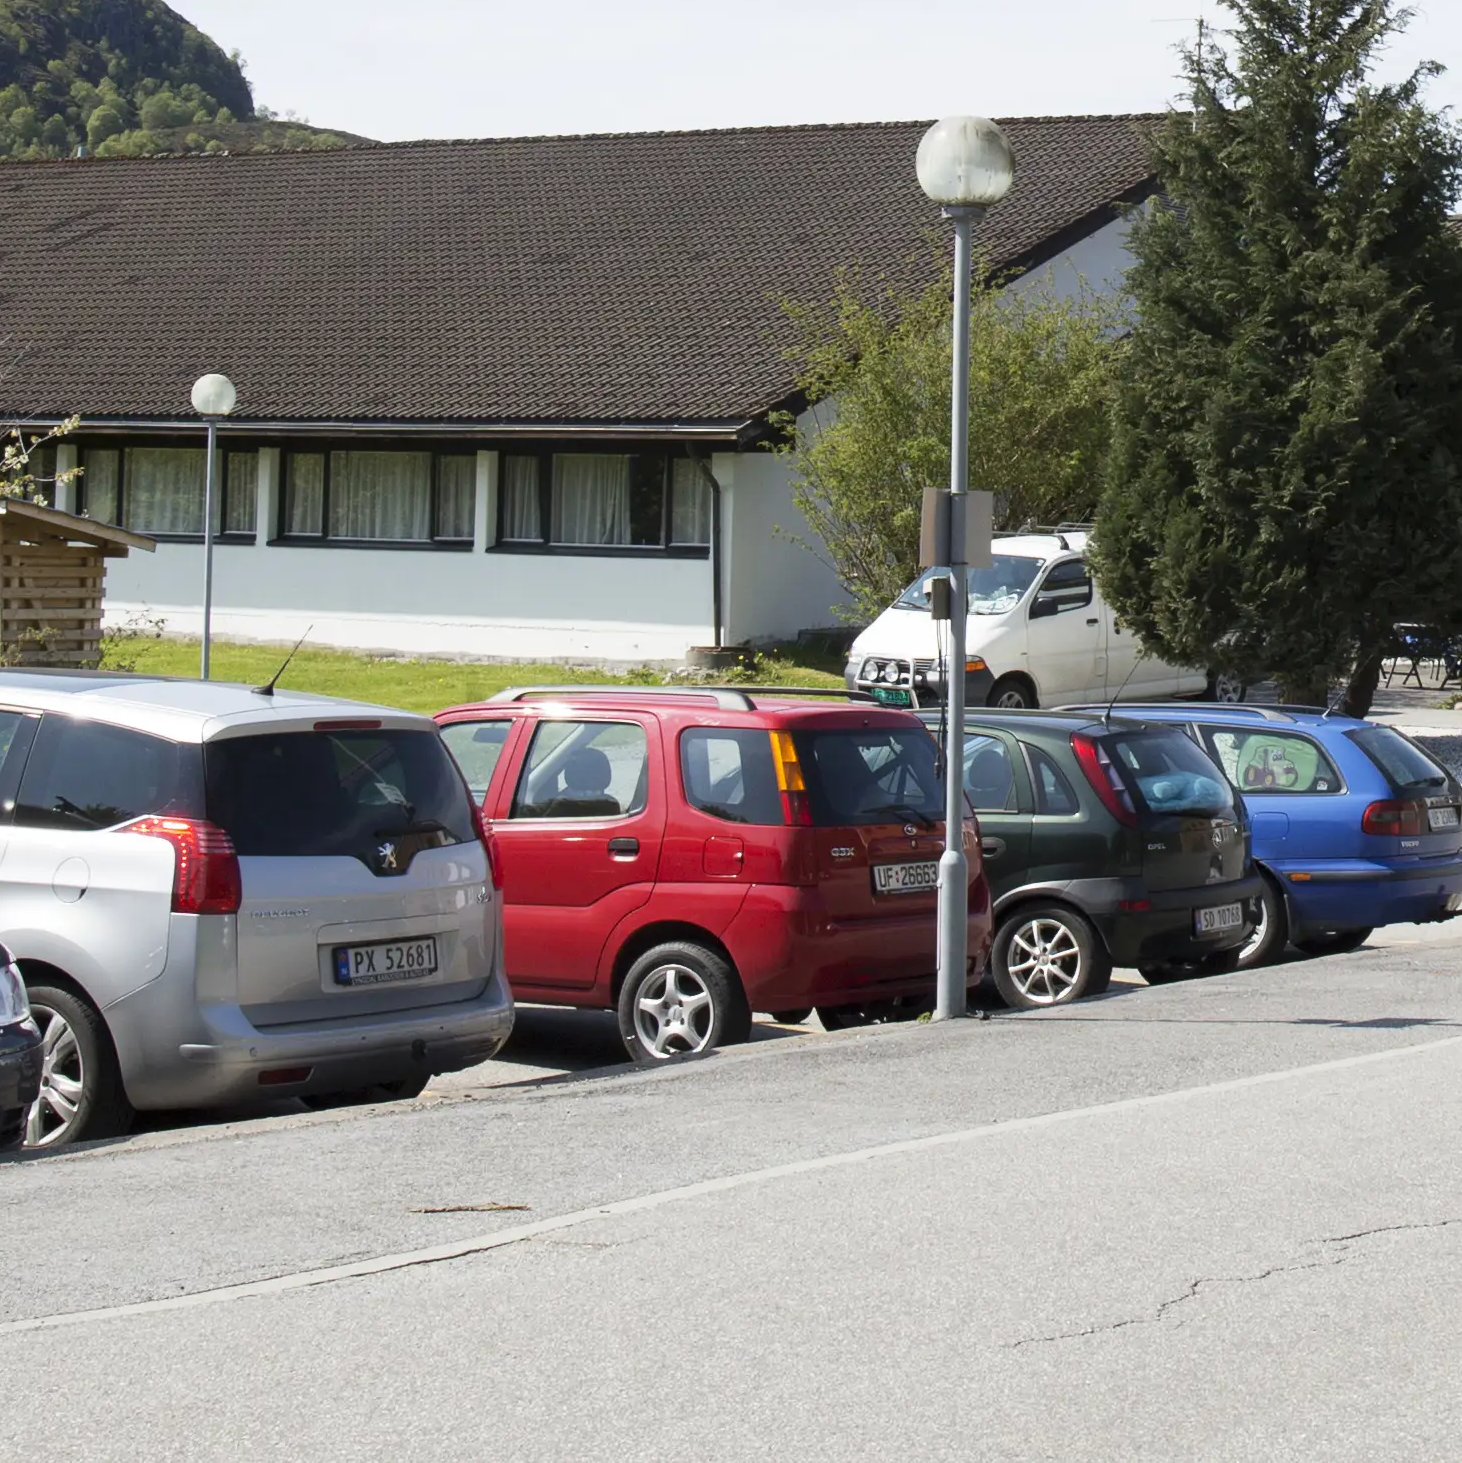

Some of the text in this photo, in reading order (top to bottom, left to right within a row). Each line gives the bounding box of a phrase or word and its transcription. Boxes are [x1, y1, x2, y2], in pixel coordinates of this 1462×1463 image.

[877, 864, 937, 888] UF 26663
[1203, 910, 1215, 928] SD
[354, 943, 432, 974] PX 52681
